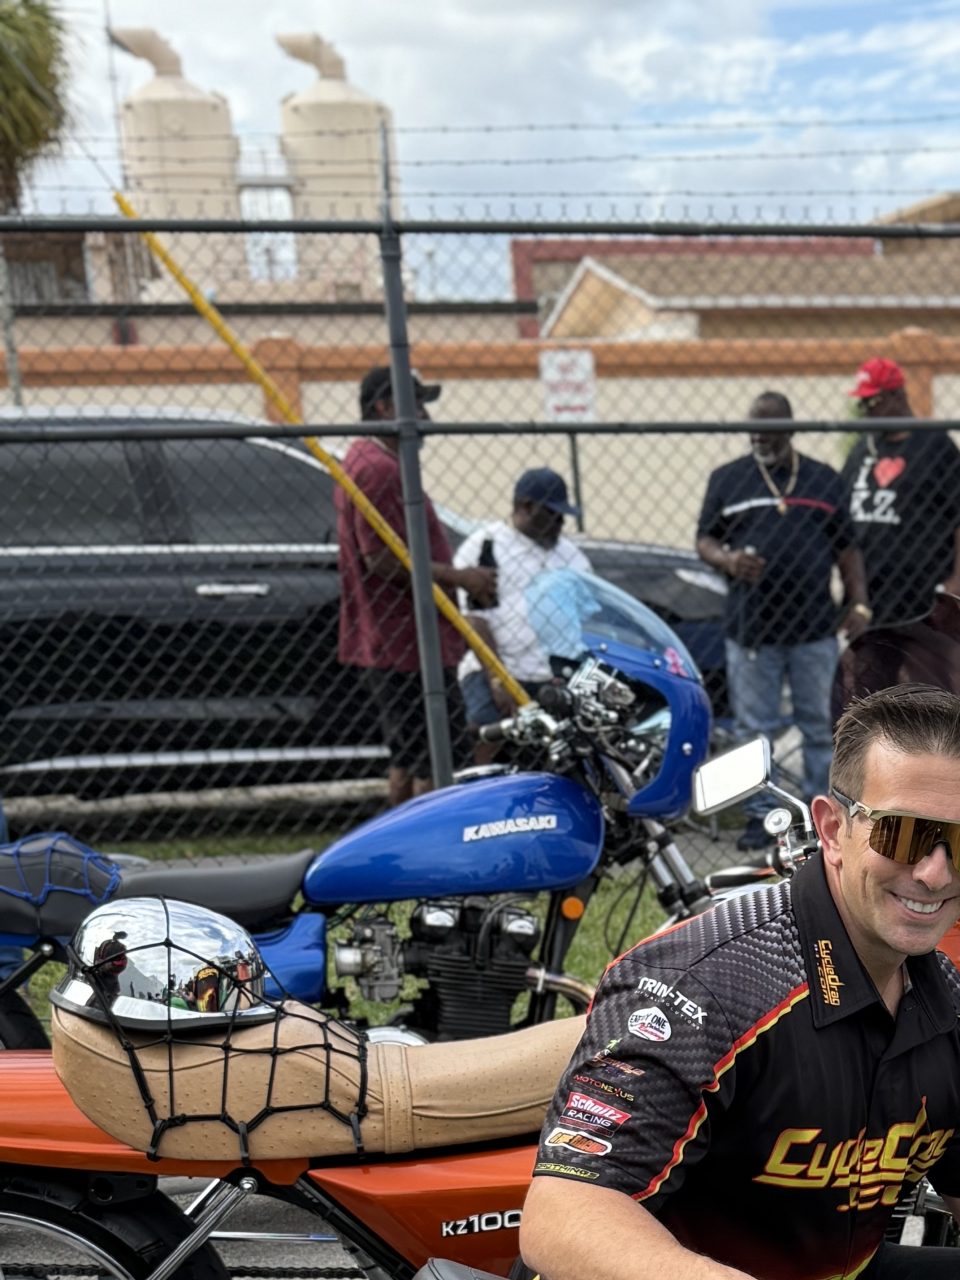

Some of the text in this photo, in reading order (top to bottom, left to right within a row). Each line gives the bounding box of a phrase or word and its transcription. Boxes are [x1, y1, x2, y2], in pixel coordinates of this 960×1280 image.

[463, 815, 557, 842] KAWASAKI
[818, 940, 845, 1006] CycleDrag
[638, 977, 708, 1025] TRIN-TEX
[650, 1014, 668, 1029] ONE
[573, 1075, 634, 1102] MOTONEXUS
[567, 1109, 613, 1127] RACING
[441, 1208, 523, 1237] KZ100
